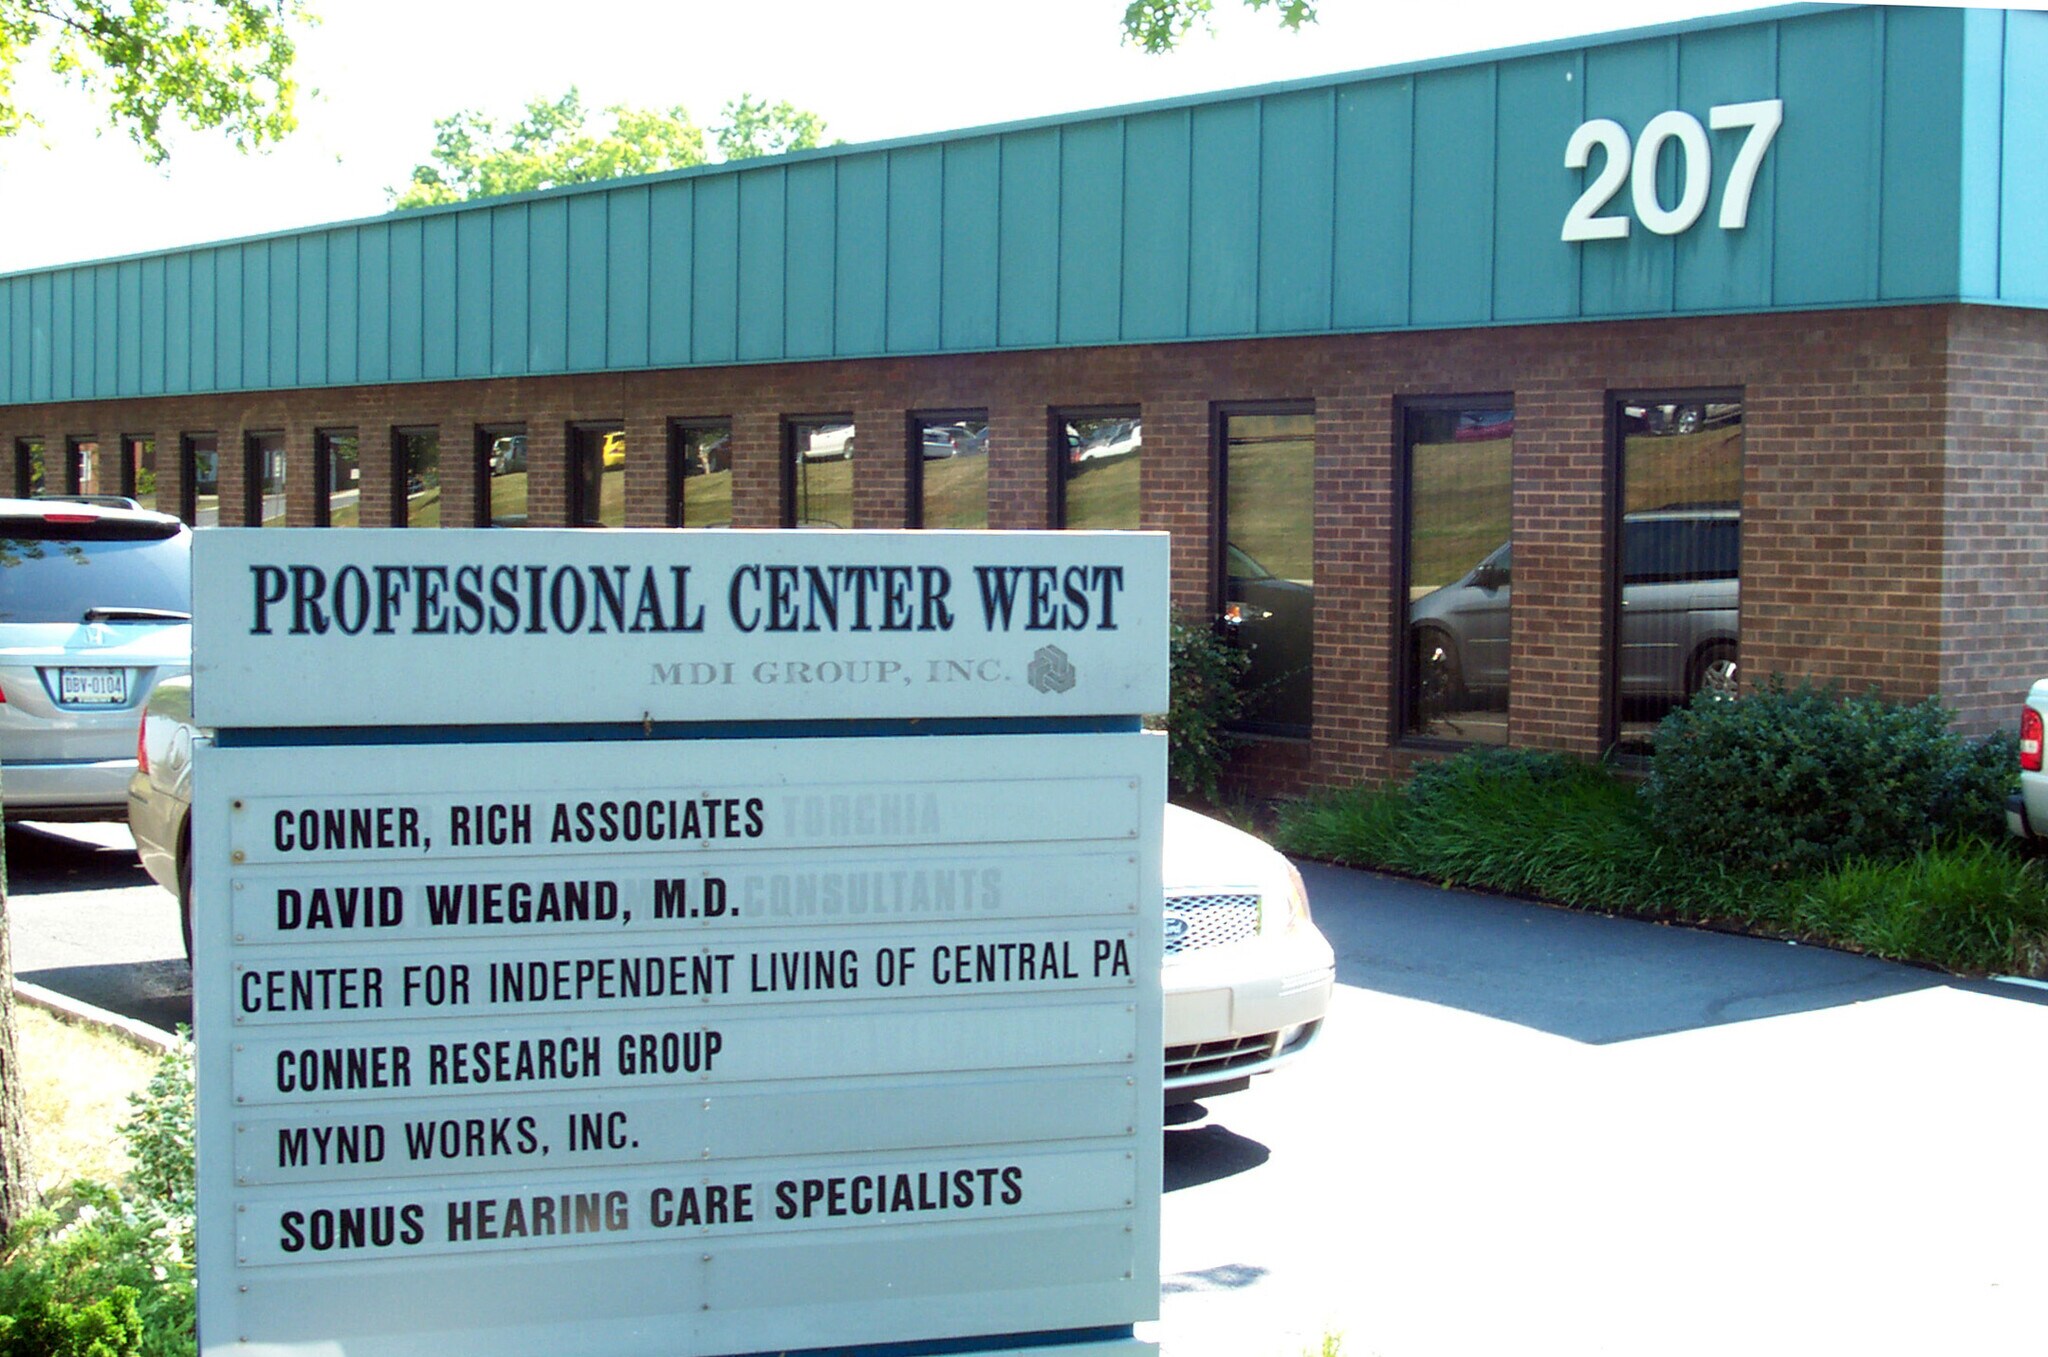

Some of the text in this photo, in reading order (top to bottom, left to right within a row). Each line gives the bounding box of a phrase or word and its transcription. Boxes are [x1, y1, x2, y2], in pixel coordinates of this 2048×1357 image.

[1561, 99, 1783, 241] 207
[249, 563, 1124, 636] PROFESSIONAL CENTER WEST
[649, 658, 1012, 687] MDI GROUP, INC.
[273, 797, 764, 853] CONNER, RICH ASSOCIATES
[276, 877, 739, 931] DAVID WIEGAND, M.D.
[744, 868, 1002, 918] CONSULTANTS
[240, 938, 1131, 1014] CENTER FOR INDEPENDENT LIVING OF CENTRAL PA
[276, 1030, 722, 1093] CONNER RESEARCH GROUP
[277, 1111, 639, 1169] MYND WORKS, INC.
[279, 1166, 1023, 1254] SONUS HEARING CARE SPECIALISTS
